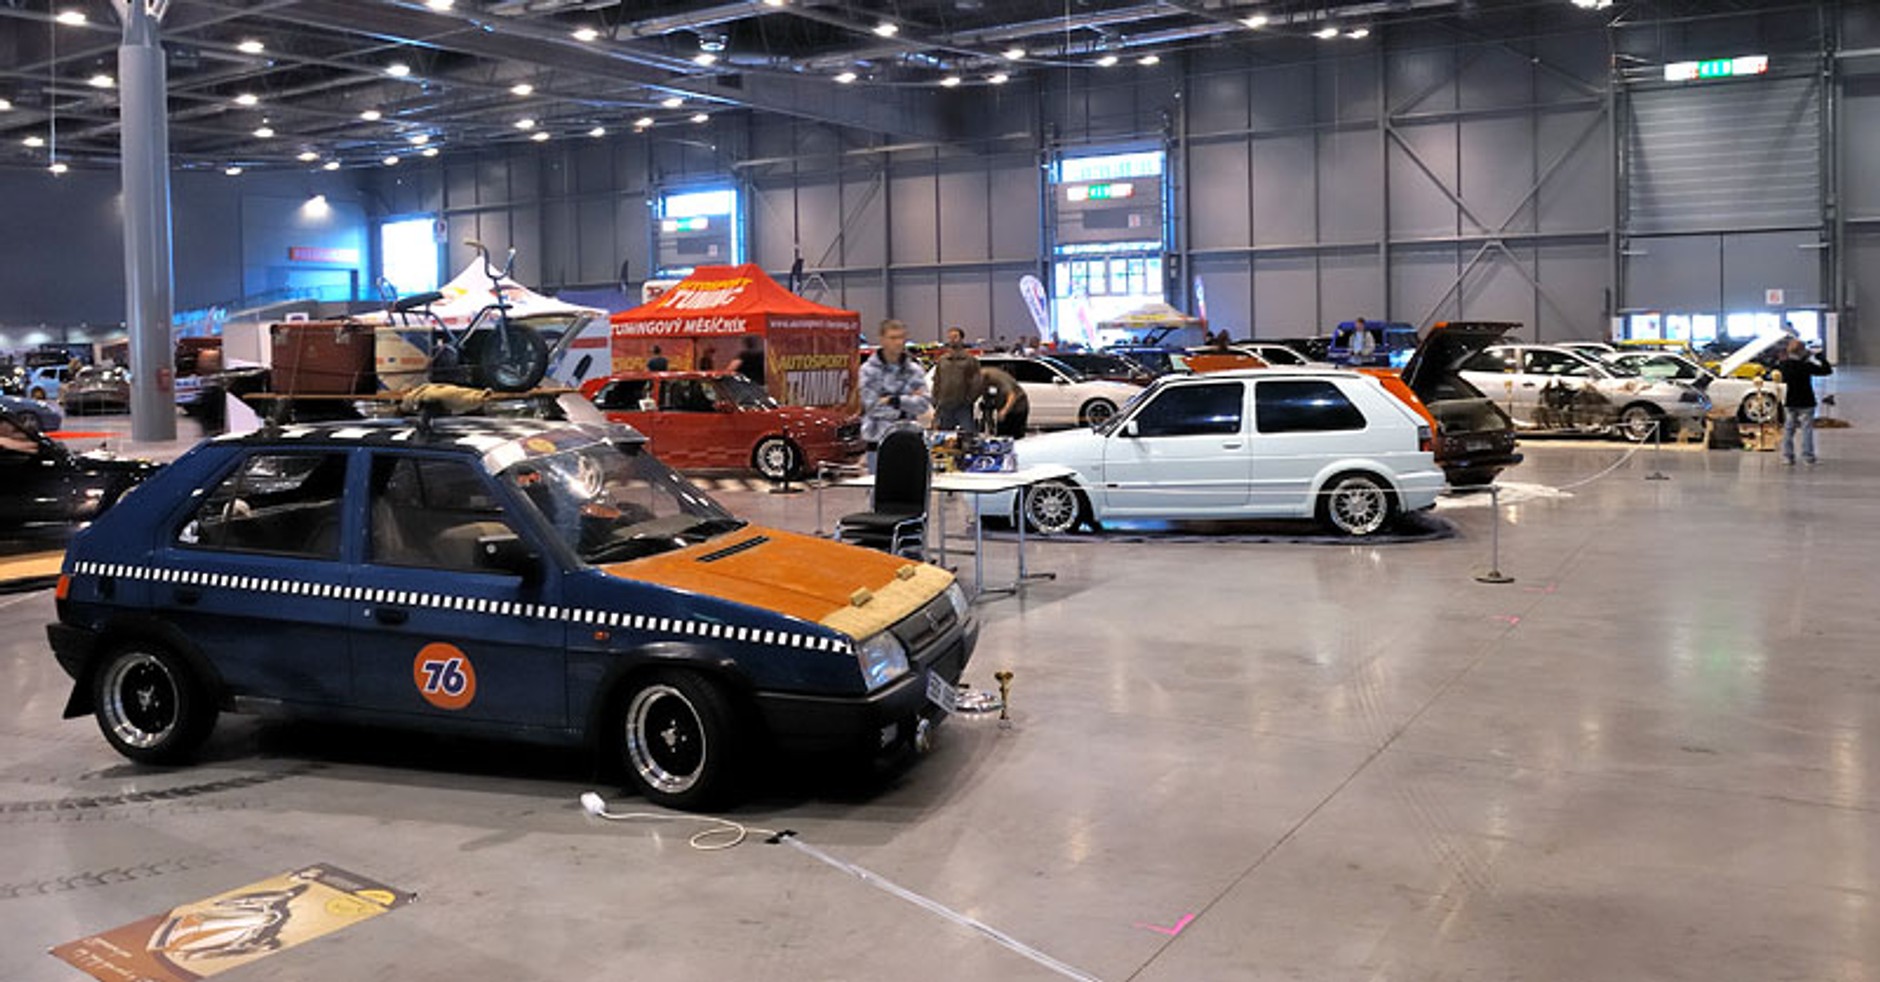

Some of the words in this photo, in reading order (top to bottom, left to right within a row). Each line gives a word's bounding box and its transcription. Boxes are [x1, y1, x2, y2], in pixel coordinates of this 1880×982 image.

[683, 315, 747, 333] MĚSÍČNÍK
[780, 354, 850, 370] AUTOSPORT
[786, 369, 850, 406] TUNING
[421, 658, 467, 697] 76
